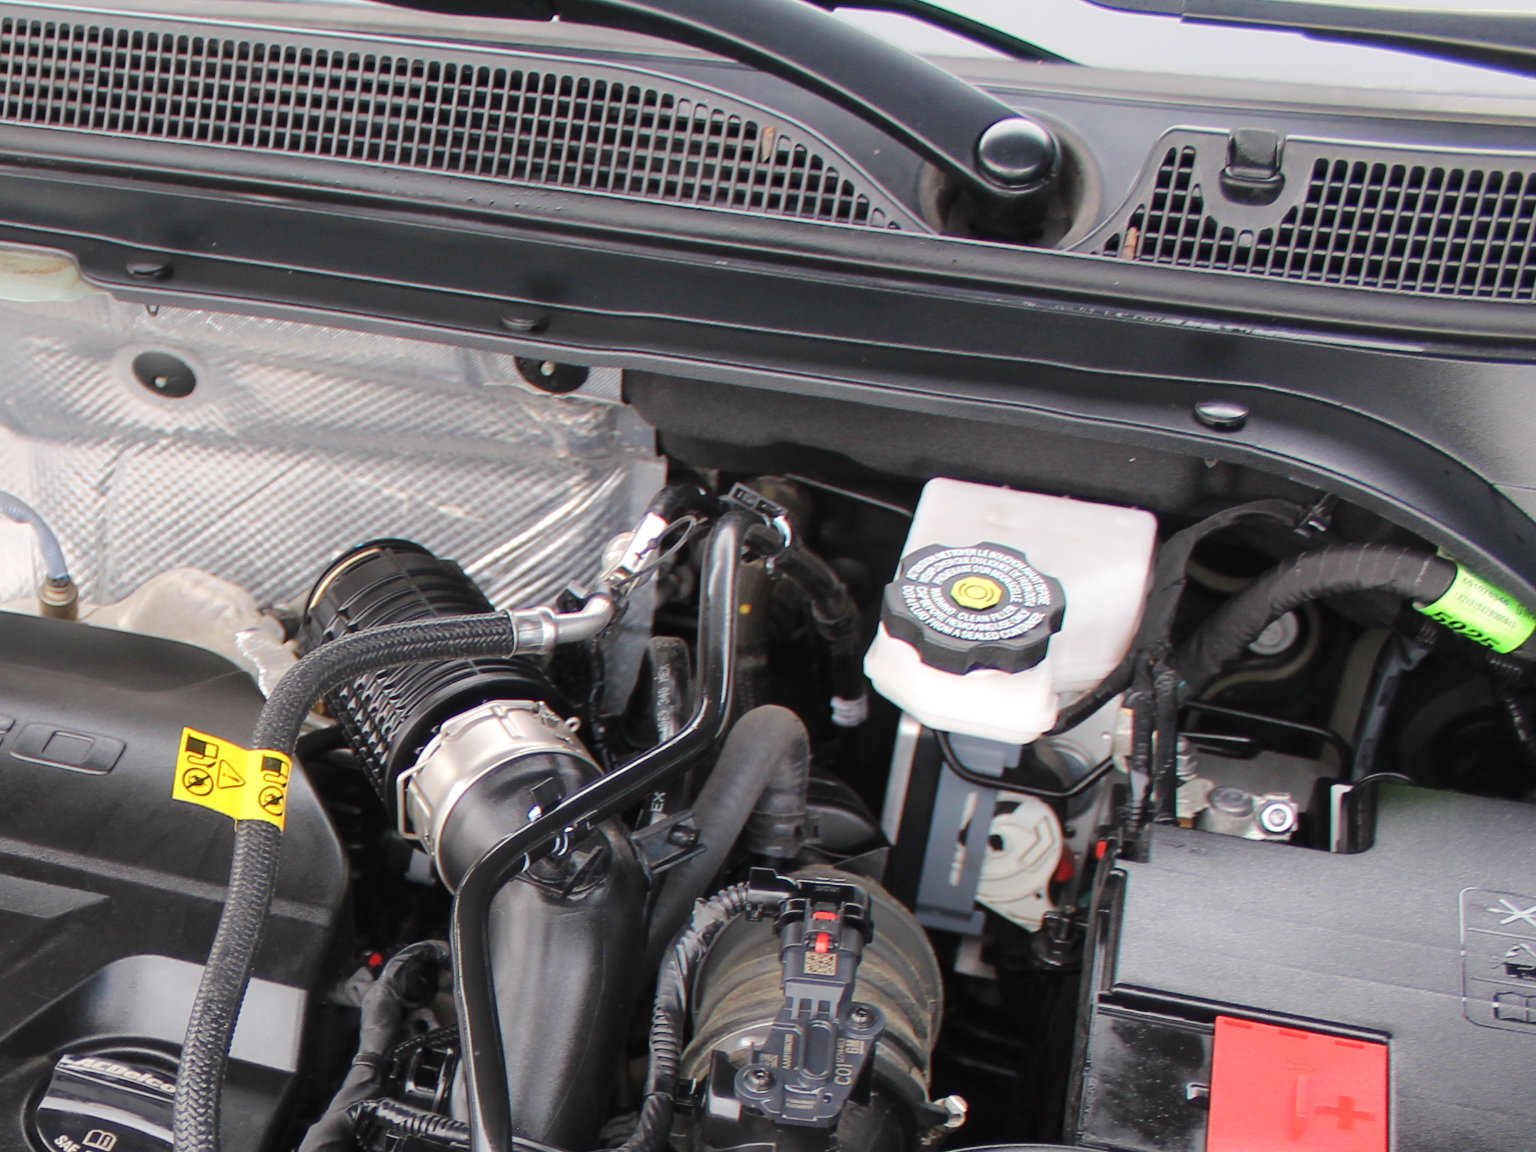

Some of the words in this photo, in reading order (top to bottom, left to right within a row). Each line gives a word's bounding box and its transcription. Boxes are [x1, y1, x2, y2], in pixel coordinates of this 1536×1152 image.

[923, 617, 955, 634] FROM
[960, 629, 1001, 639] SEALED
[74, 1057, 177, 1093] ACDelco
